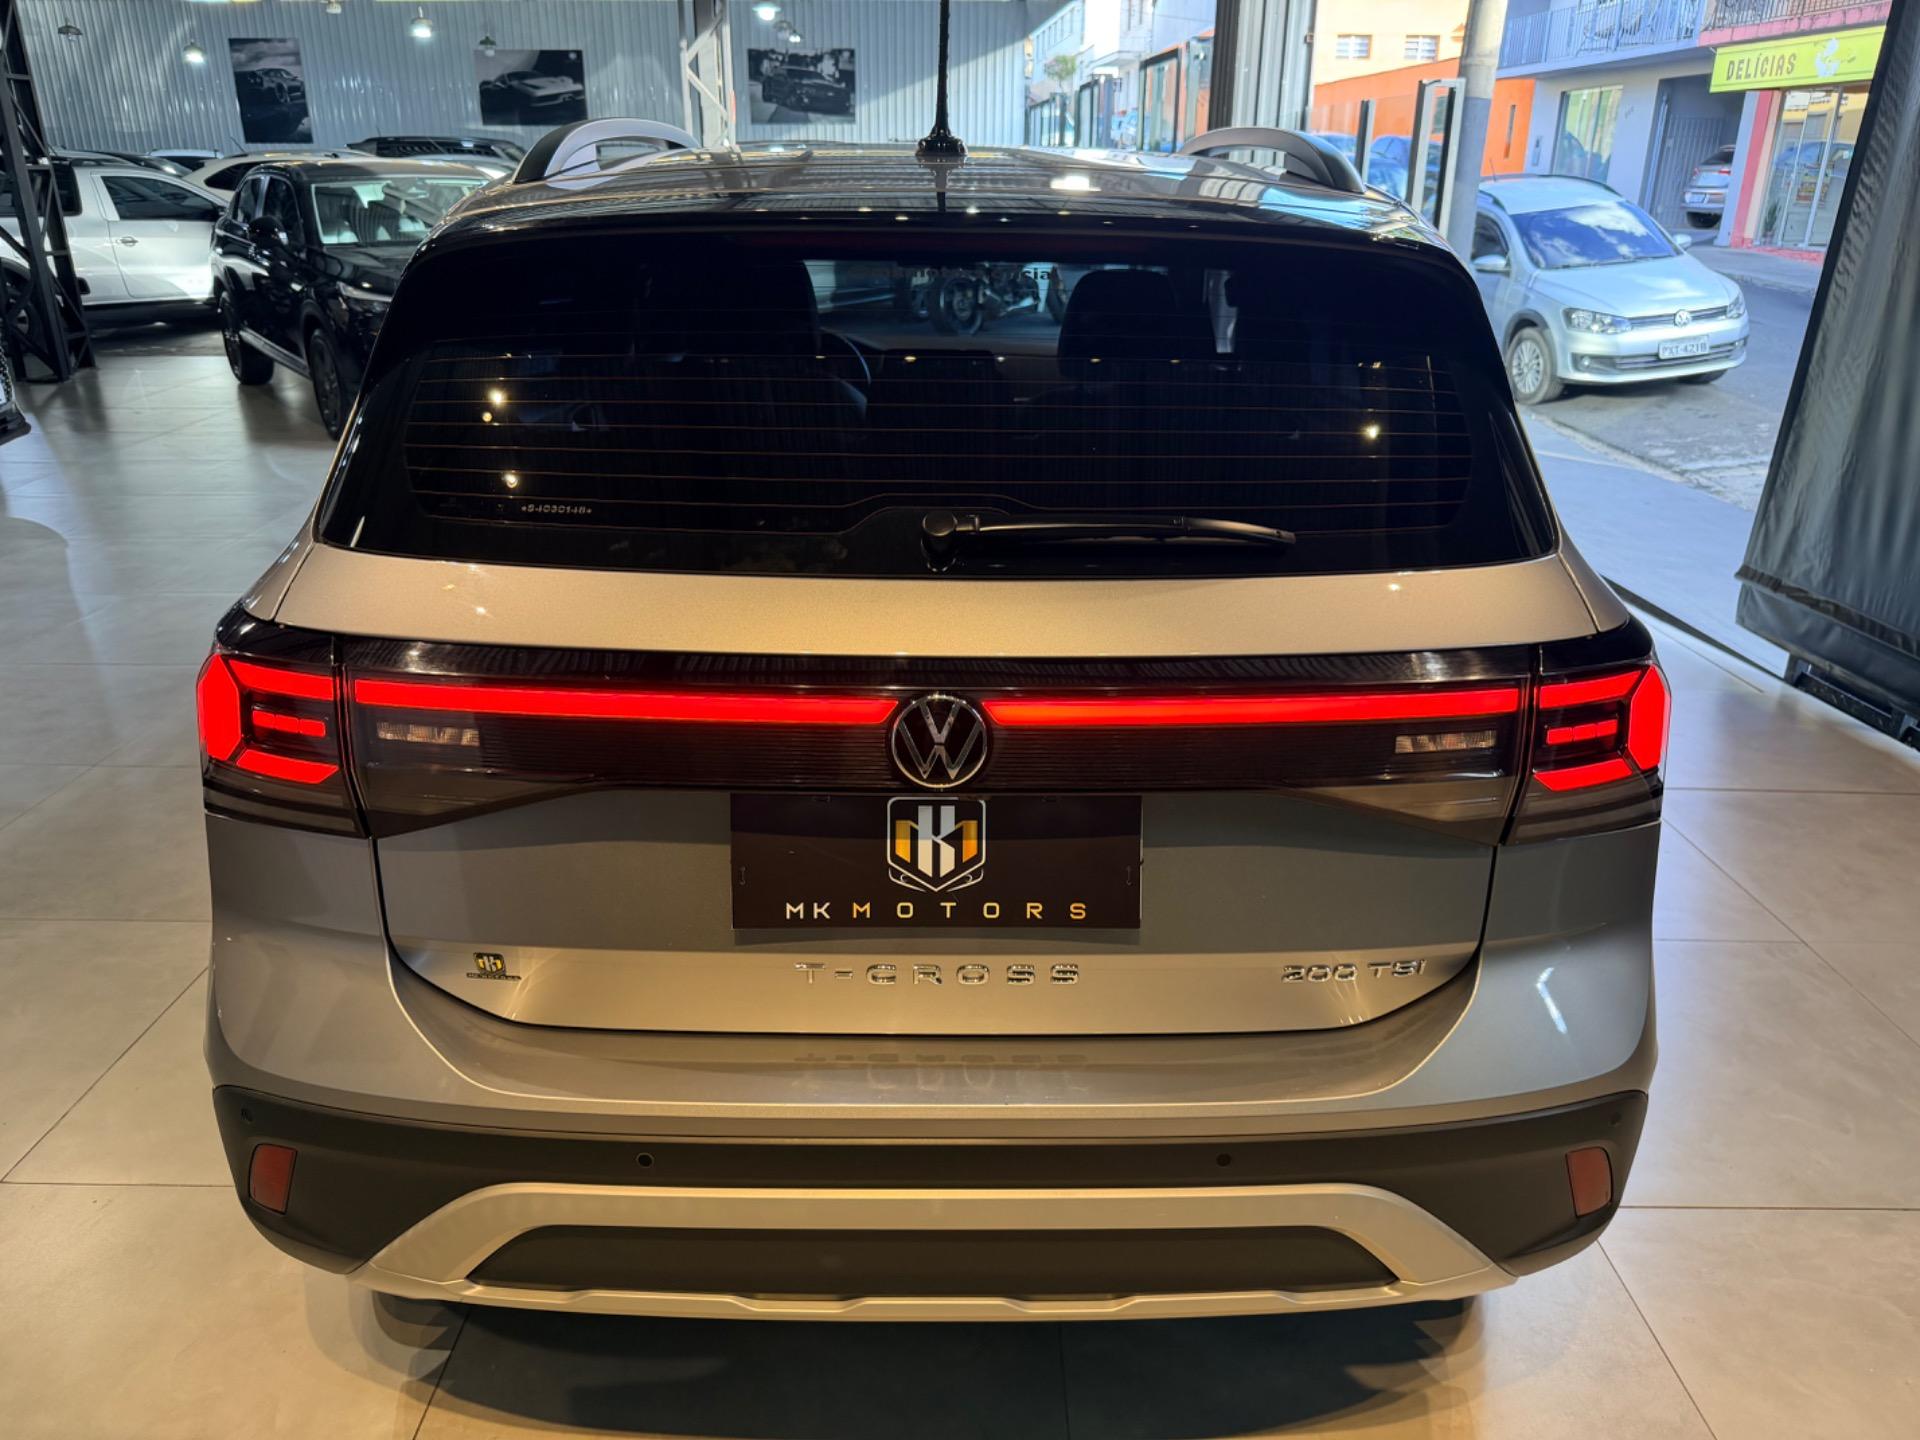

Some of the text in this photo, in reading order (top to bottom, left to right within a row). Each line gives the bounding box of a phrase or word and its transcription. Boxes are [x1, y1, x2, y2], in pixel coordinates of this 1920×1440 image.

[1726, 52, 1797, 81] DELÍCIAS
[794, 962, 1080, 985] T-CROSS
[1281, 958, 1427, 983] 200 TSI
